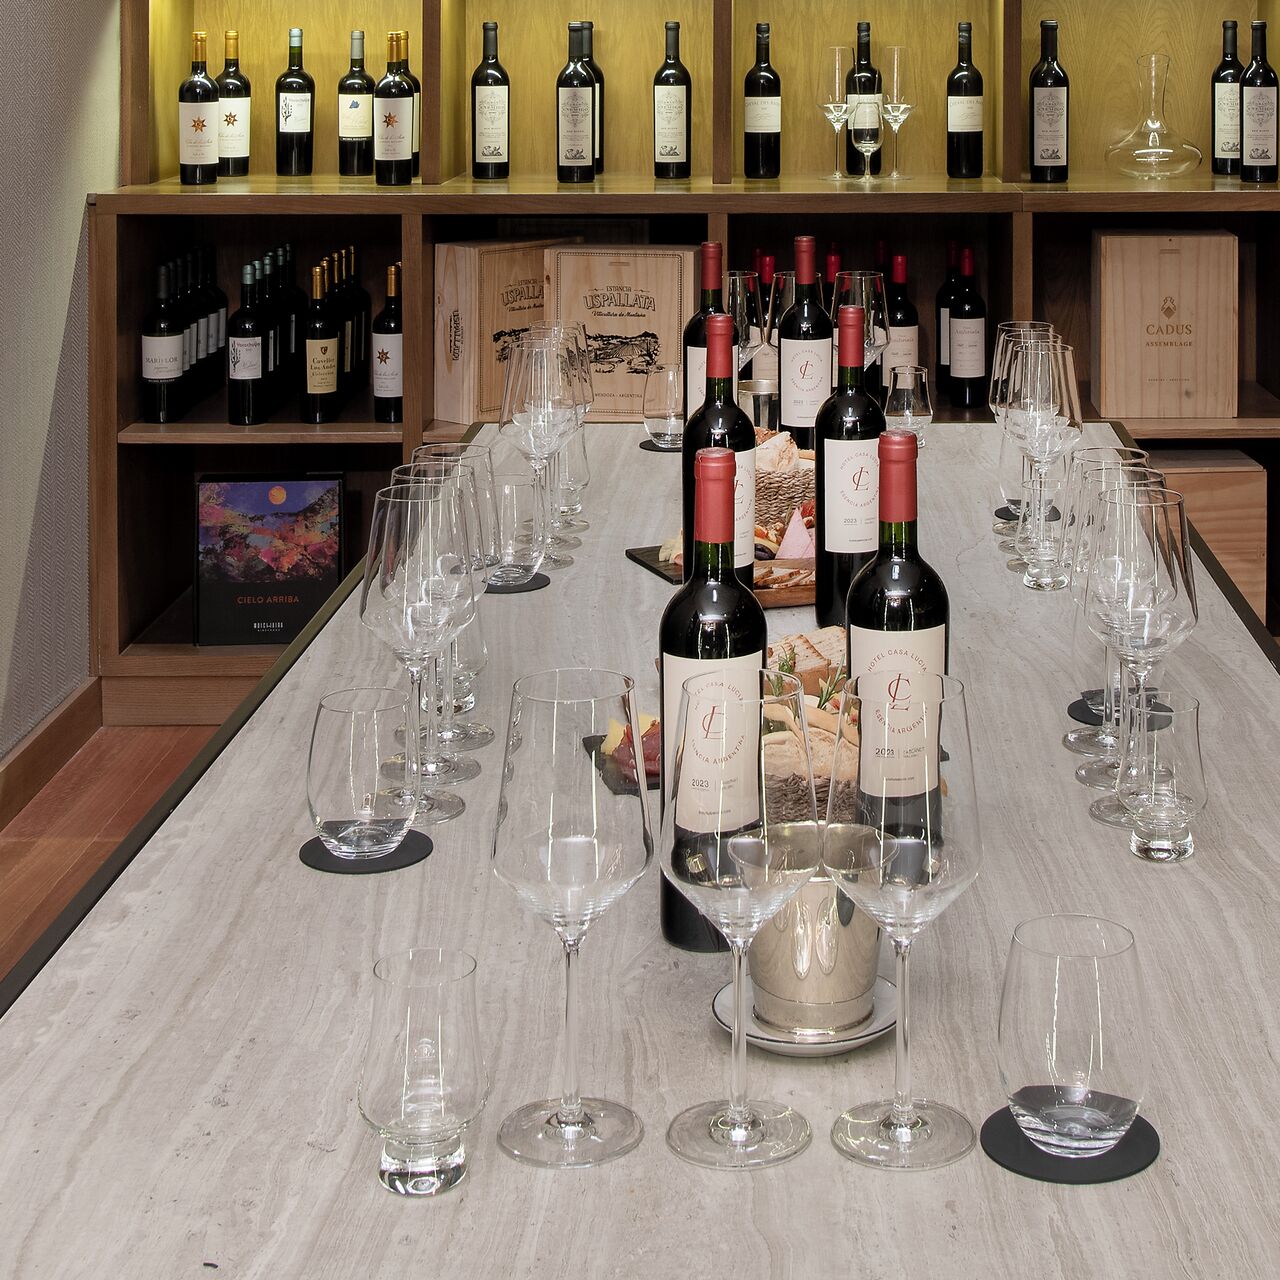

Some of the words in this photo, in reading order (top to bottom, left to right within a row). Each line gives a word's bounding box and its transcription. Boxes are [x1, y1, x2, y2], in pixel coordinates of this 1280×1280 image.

[606, 285, 632, 293] ESTANCIA
[500, 285, 544, 307] USPALLA
[583, 293, 656, 312] USPALLATA
[1146, 323, 1192, 336] CADUS
[237, 596, 264, 604] CIELO
[266, 595, 300, 604] ARRIBA
[868, 651, 886, 673] HOTEL
[887, 648, 909, 656] CASA
[910, 652, 928, 673] LUCIA
[691, 778, 710, 788] 2023
